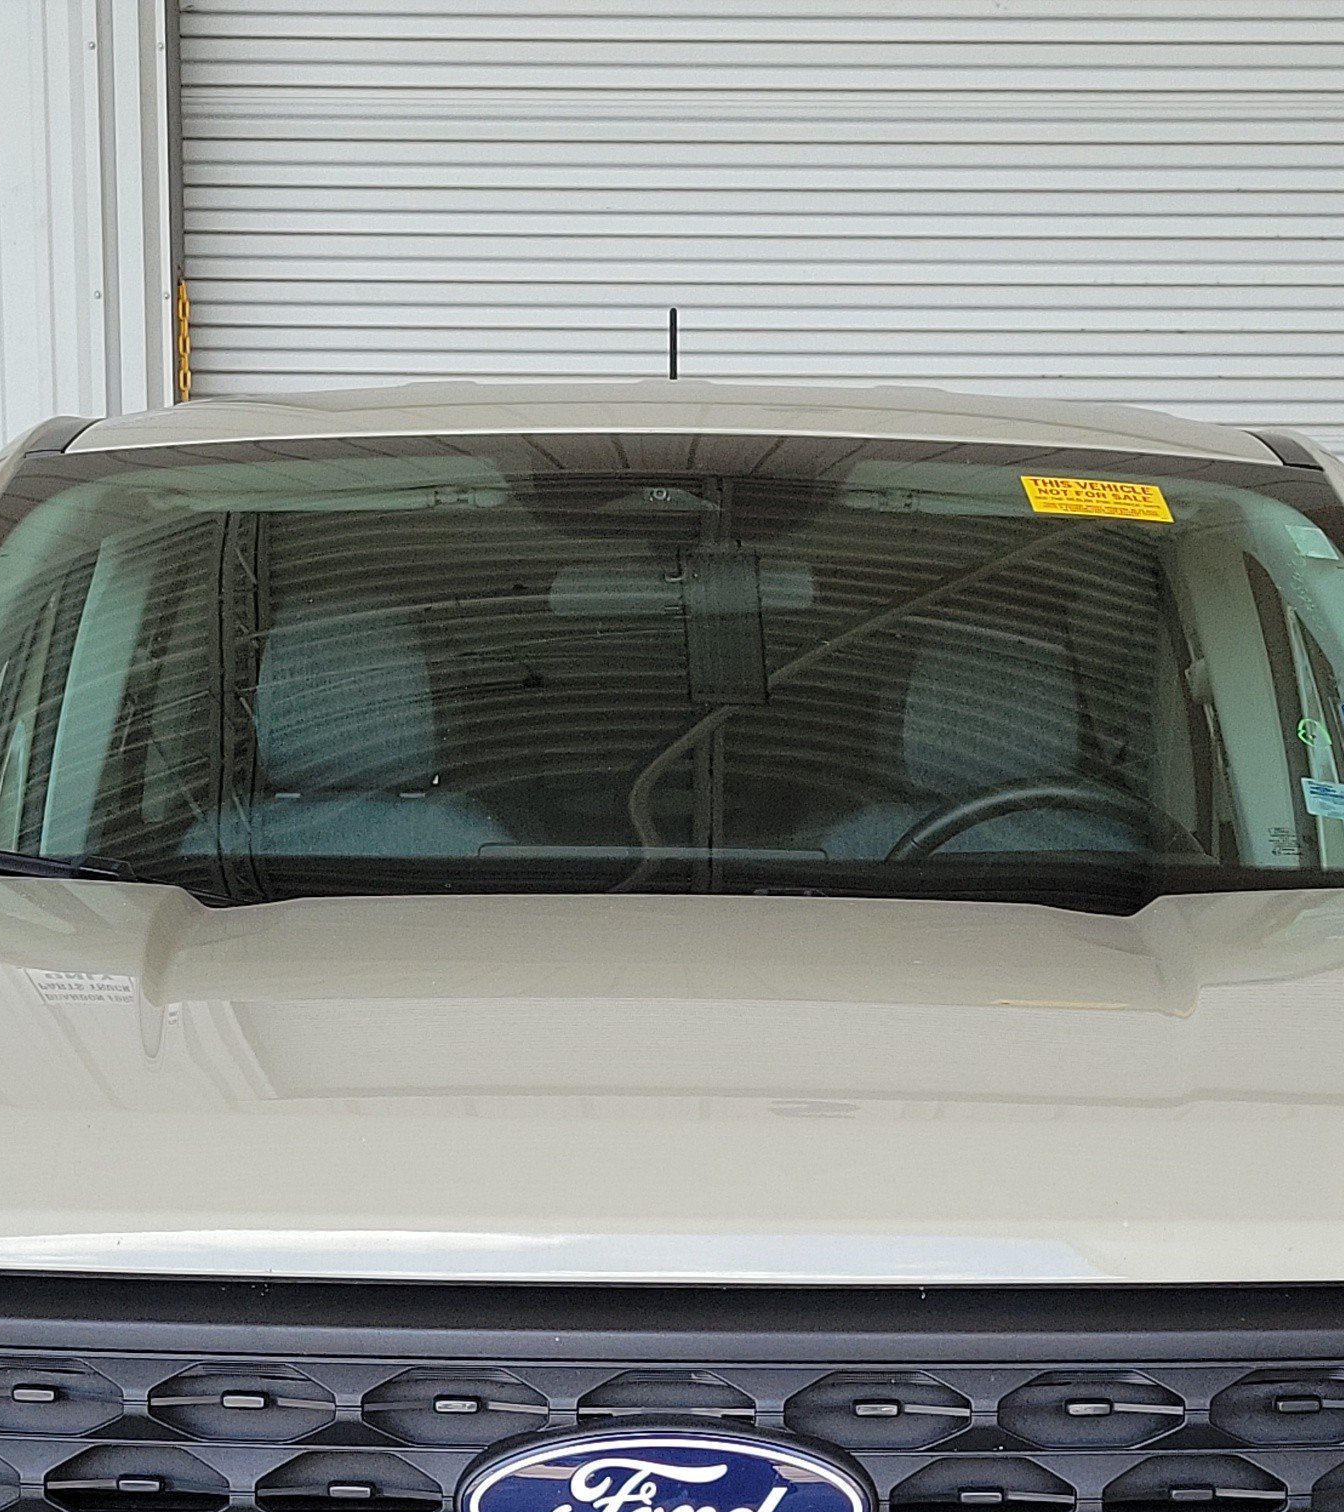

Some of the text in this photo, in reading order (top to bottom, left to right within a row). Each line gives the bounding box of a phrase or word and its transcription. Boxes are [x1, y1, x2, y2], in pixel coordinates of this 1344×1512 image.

[1030, 479, 1153, 495] THIS VEHICLE
[1038, 487, 1068, 496] NOT
[1075, 490, 1107, 499] FOR
[1112, 493, 1153, 503] SALE
